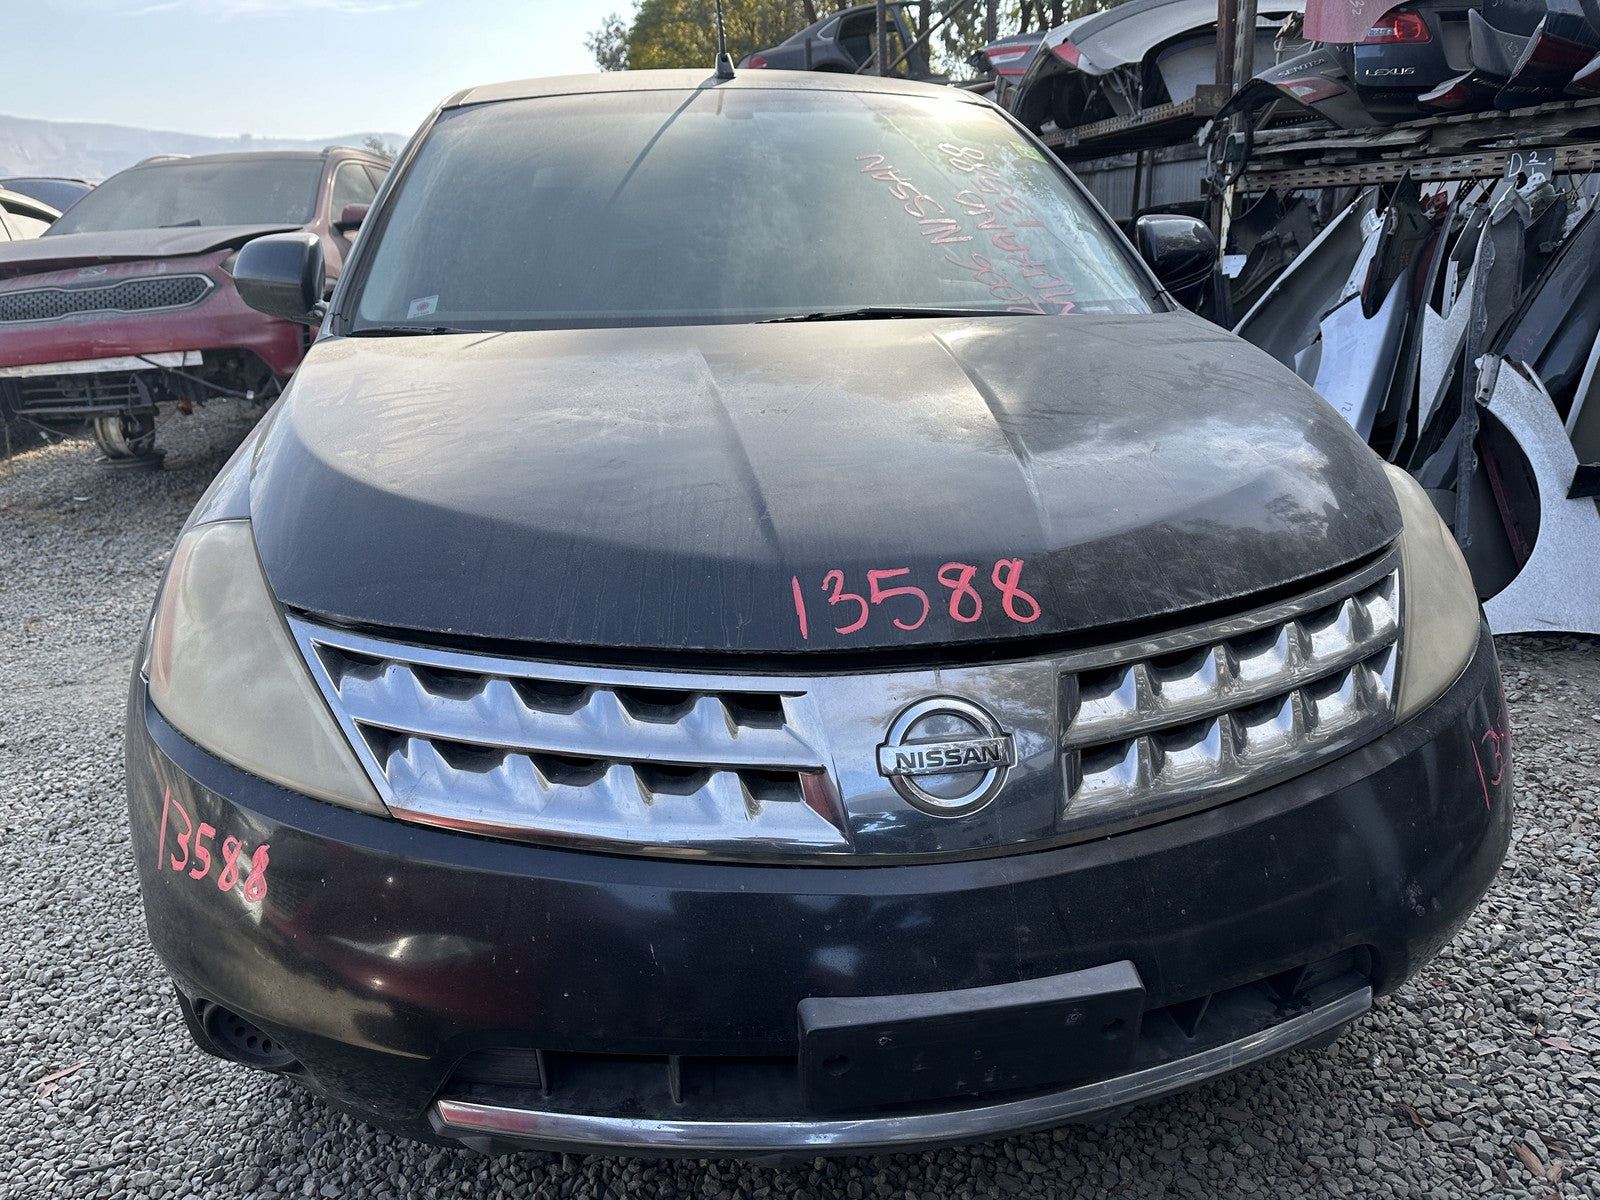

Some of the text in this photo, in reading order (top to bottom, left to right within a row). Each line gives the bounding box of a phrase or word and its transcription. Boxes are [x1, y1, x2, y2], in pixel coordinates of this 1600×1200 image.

[1278, 58, 1328, 78] SENTRA
[1365, 67, 1415, 76] LEXUS
[1508, 151, 1539, 177] D 2
[855, 153, 973, 244] NISSAN
[953, 189, 1076, 315] MURANO
[792, 558, 1041, 639] 13588
[895, 744, 1000, 769] NISSAN
[158, 785, 270, 903] 13588
